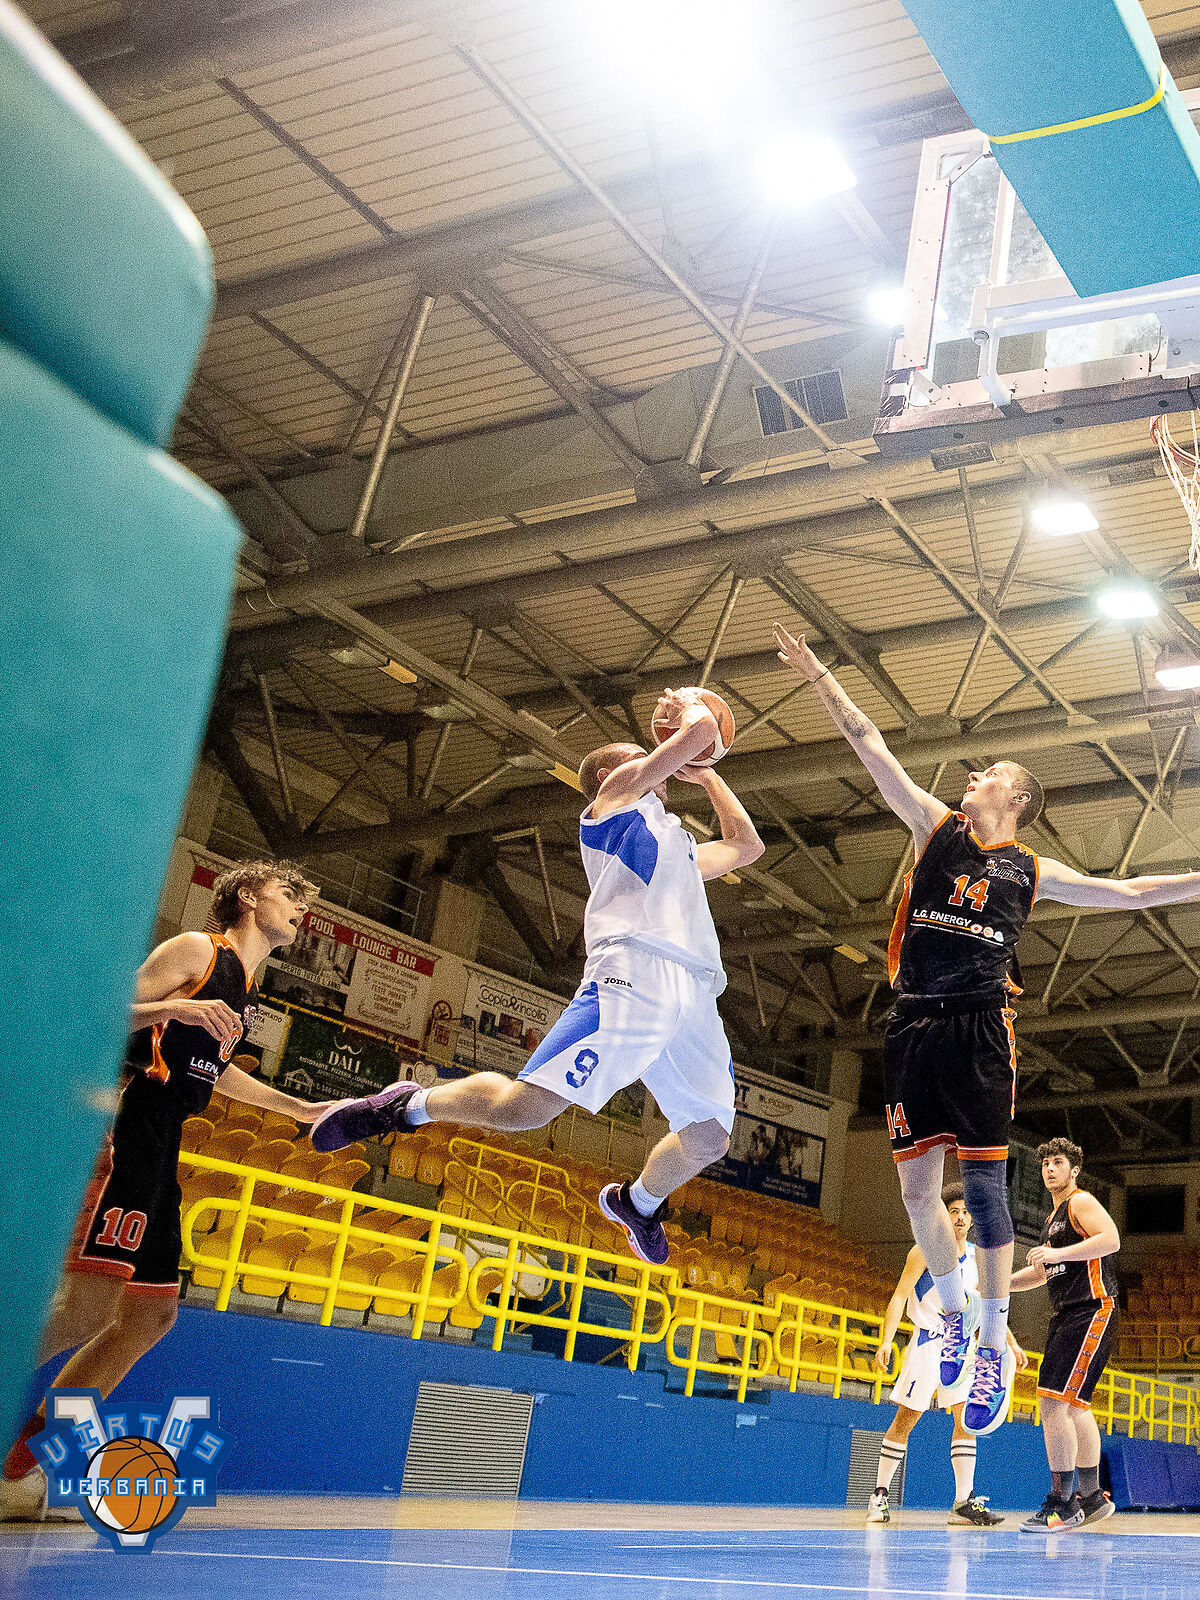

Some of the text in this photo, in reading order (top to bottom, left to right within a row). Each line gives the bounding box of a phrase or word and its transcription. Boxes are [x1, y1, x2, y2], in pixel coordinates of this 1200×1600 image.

[947, 874, 990, 912] 14
[929, 910, 972, 927] ENERGY
[308, 915, 417, 969] POOL LOUNGE BAR
[565, 1048, 599, 1089] 9
[95, 1207, 147, 1251] 10
[906, 1380, 917, 1398] 1
